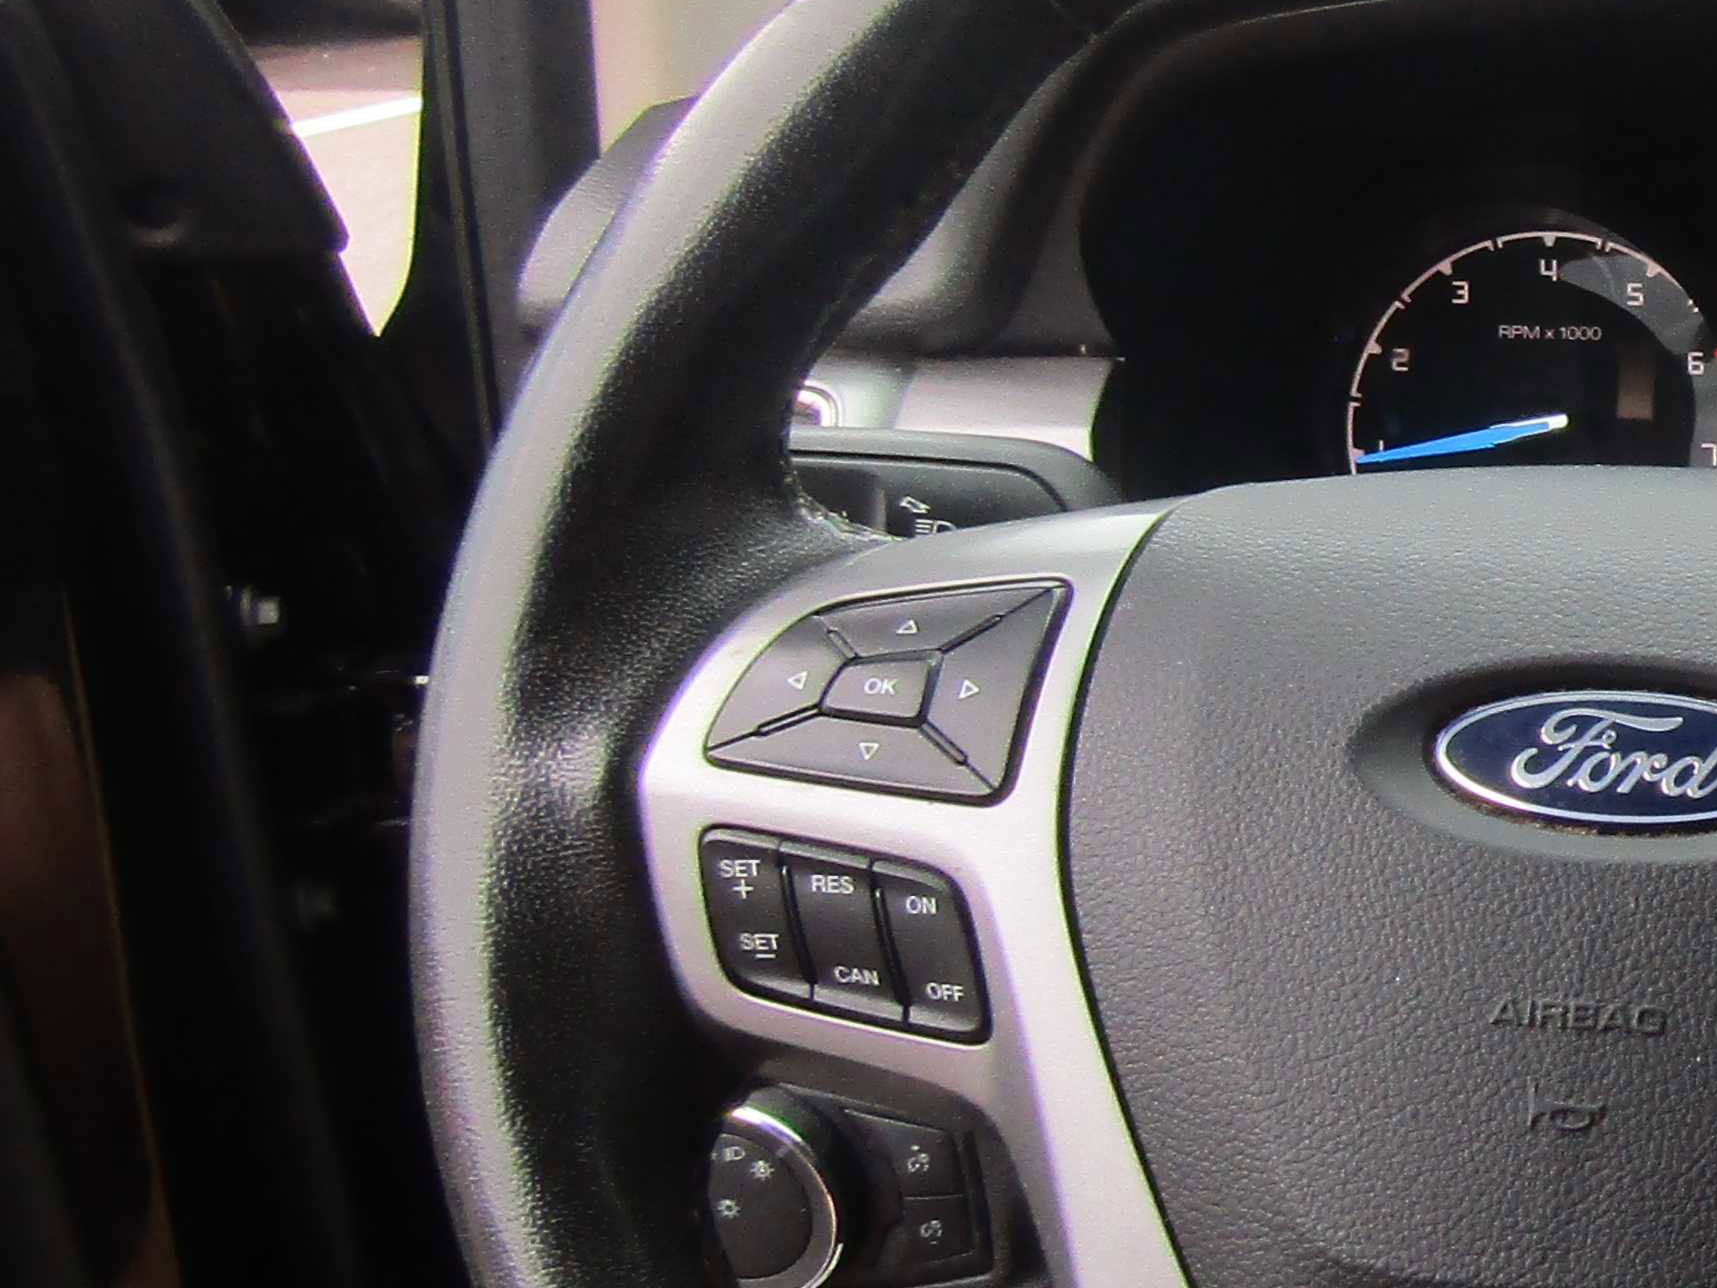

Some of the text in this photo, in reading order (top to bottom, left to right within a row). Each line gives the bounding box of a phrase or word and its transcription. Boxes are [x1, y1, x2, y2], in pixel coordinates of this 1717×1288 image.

[1540, 259, 1559, 282] 4
[1452, 281, 1470, 304] 3
[1626, 283, 1644, 306] 5
[1499, 325, 1541, 340] RPM
[1559, 326, 1602, 341] 1000
[1391, 348, 1410, 372] 2
[1687, 351, 1704, 375] 6
[1700, 443, 1717, 467] 7
[863, 678, 898, 696] OK
[718, 859, 761, 879] SET
[811, 874, 855, 895] RES
[905, 896, 937, 915] ON
[739, 932, 779, 952] SET
[833, 965, 880, 987] CAN
[925, 983, 964, 1003] OFF
[1489, 995, 1667, 1037] AIRBAG
